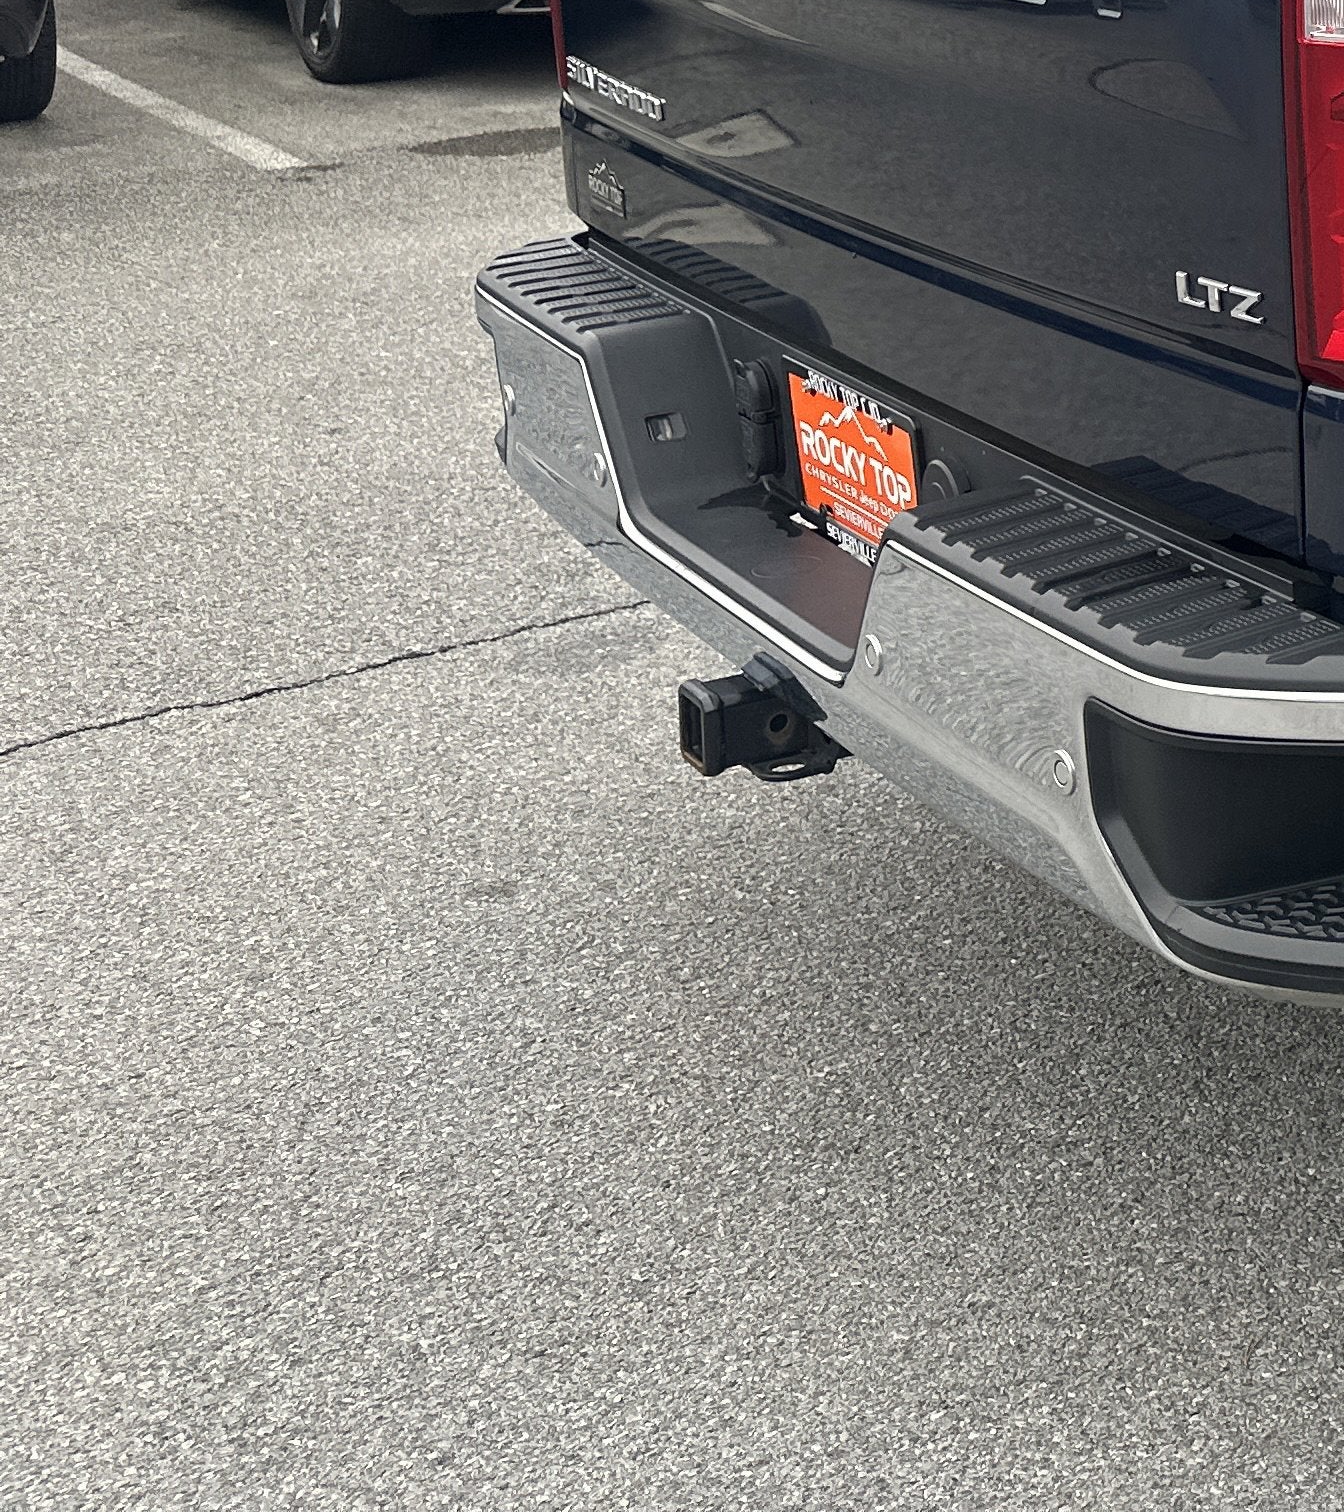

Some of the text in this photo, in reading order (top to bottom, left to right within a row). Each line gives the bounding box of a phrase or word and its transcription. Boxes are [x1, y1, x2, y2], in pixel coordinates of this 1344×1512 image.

[566, 55, 666, 122] SILVERADO
[1175, 270, 1264, 325] LTZ
[800, 420, 912, 510] ROCKY TOP
[805, 462, 859, 500] CHRYSLER
